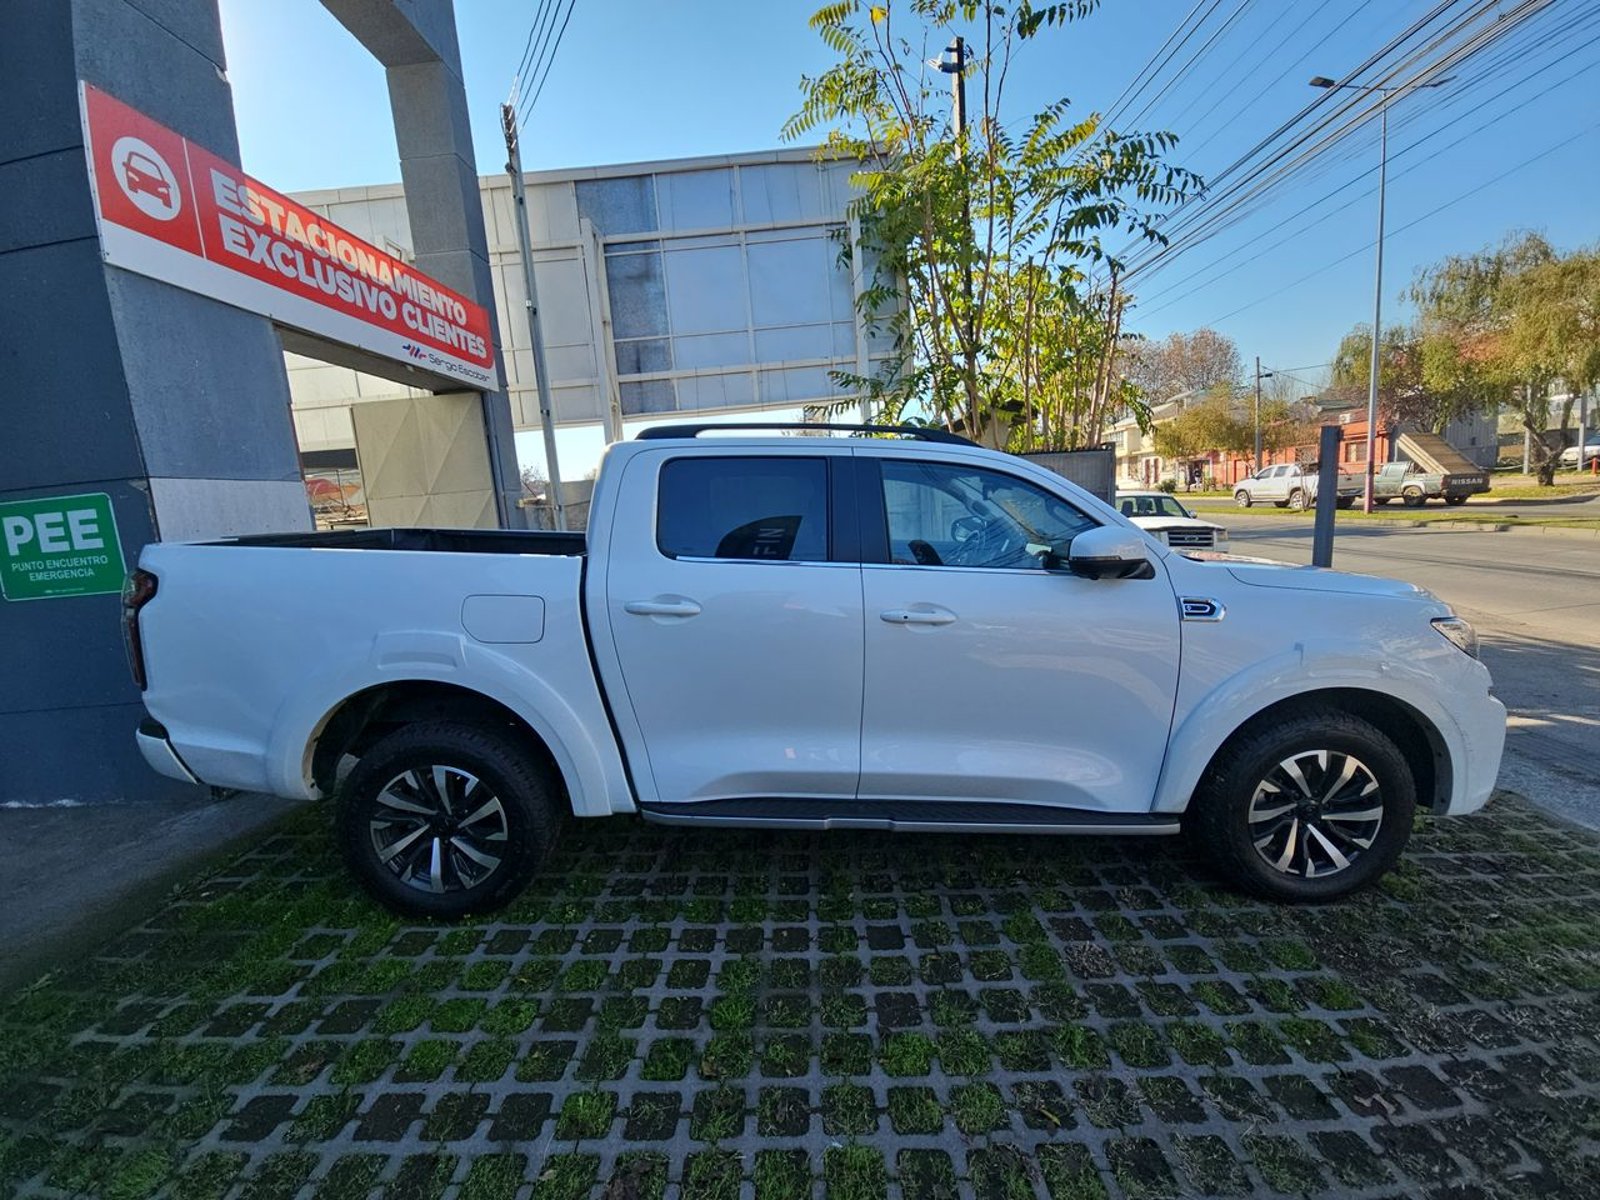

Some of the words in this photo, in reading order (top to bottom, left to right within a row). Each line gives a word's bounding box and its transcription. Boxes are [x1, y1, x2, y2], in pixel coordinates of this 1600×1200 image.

[210, 167, 467, 326] ESTACIONAMIENTO
[218, 213, 397, 320] EXCLUSIVO
[401, 303, 487, 359] CLIENTES
[2, 508, 105, 556] PEE
[11, 560, 45, 572] PUNTO
[46, 555, 108, 569] ENCUENTRO
[29, 568, 96, 582] EMERGENCIA
